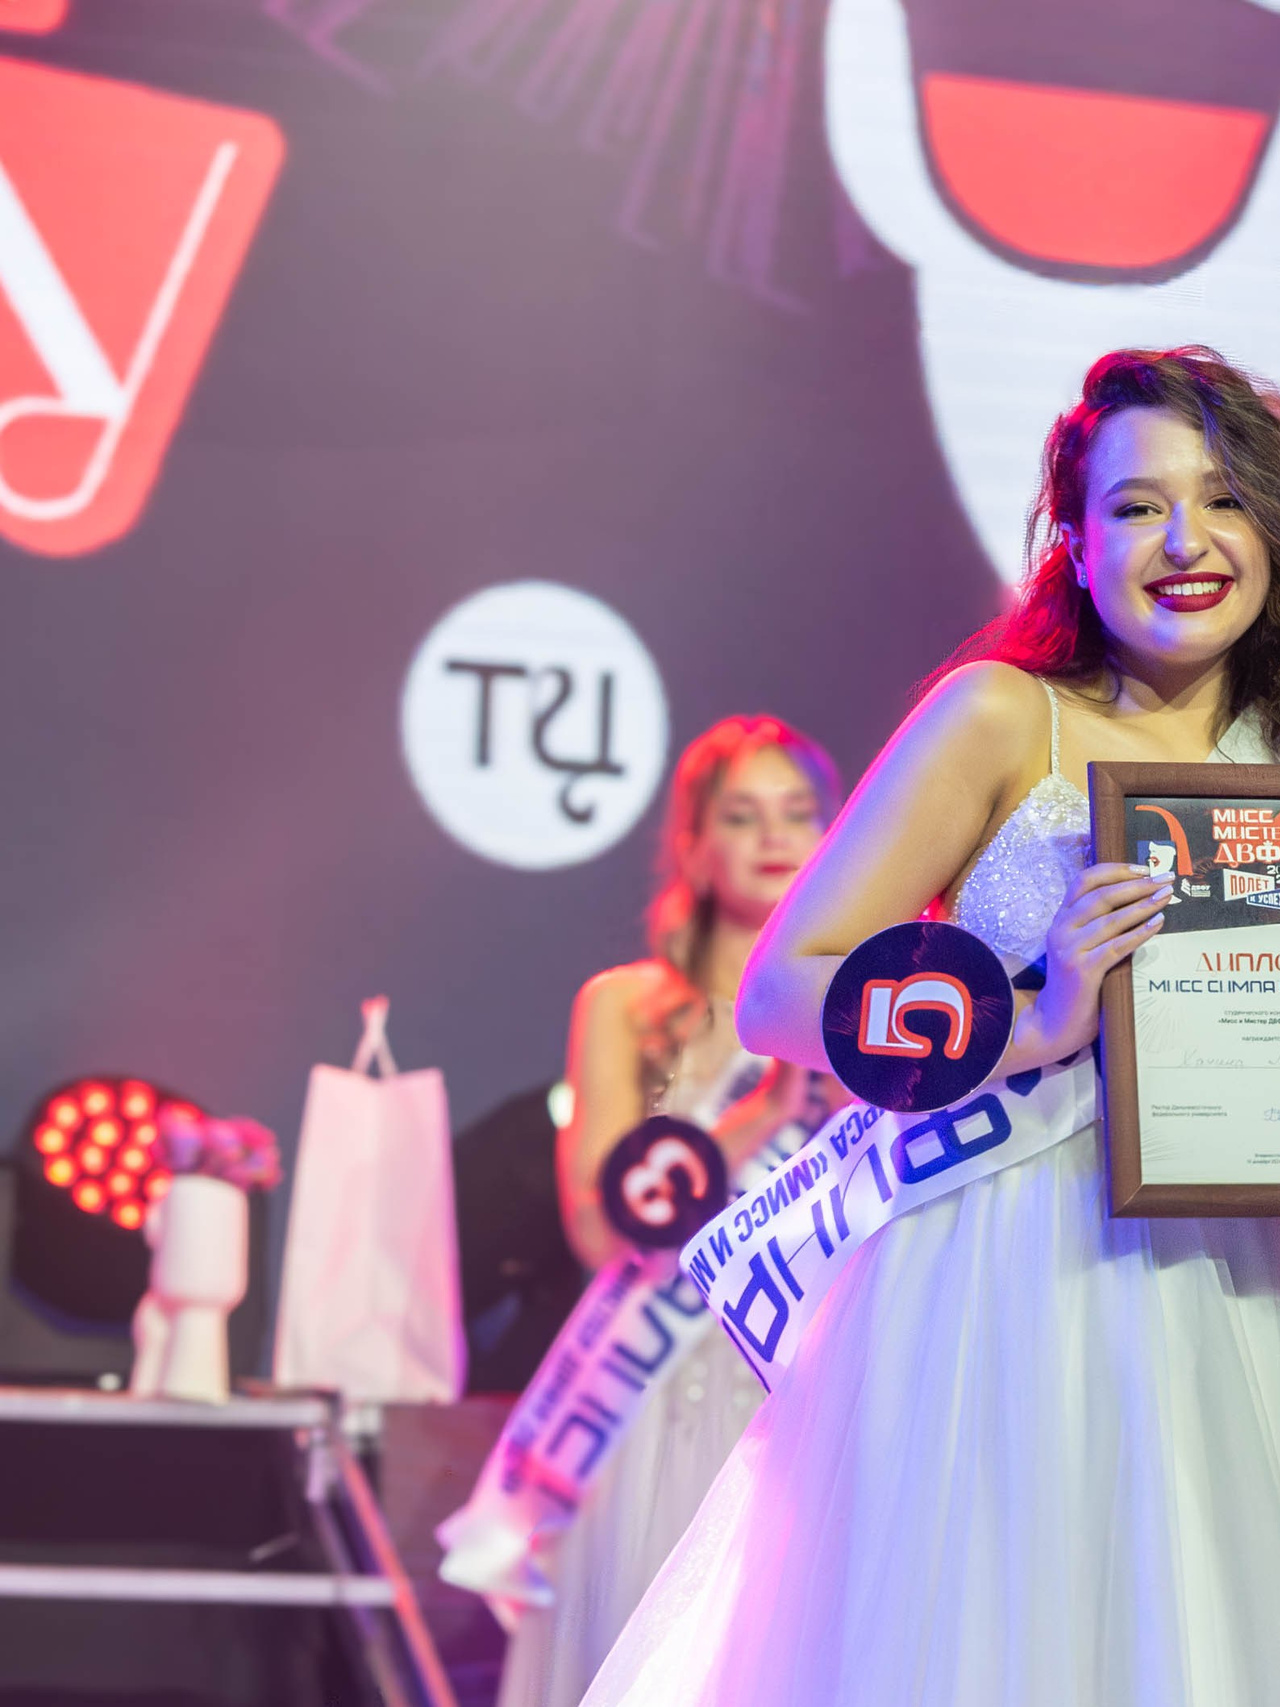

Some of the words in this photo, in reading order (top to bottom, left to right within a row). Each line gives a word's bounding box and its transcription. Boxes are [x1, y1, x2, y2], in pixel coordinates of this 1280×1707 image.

[1213, 809, 1273, 824] МИСС
[1230, 874, 1269, 896] ПОЛЕТ
[1149, 979, 1202, 993] МИСС
[862, 976, 969, 1055] 5
[828, 1104, 886, 1162] РСА
[621, 1136, 709, 1227] 3
[708, 1226, 734, 1269] И
[722, 1093, 1012, 1392] ФИНА
